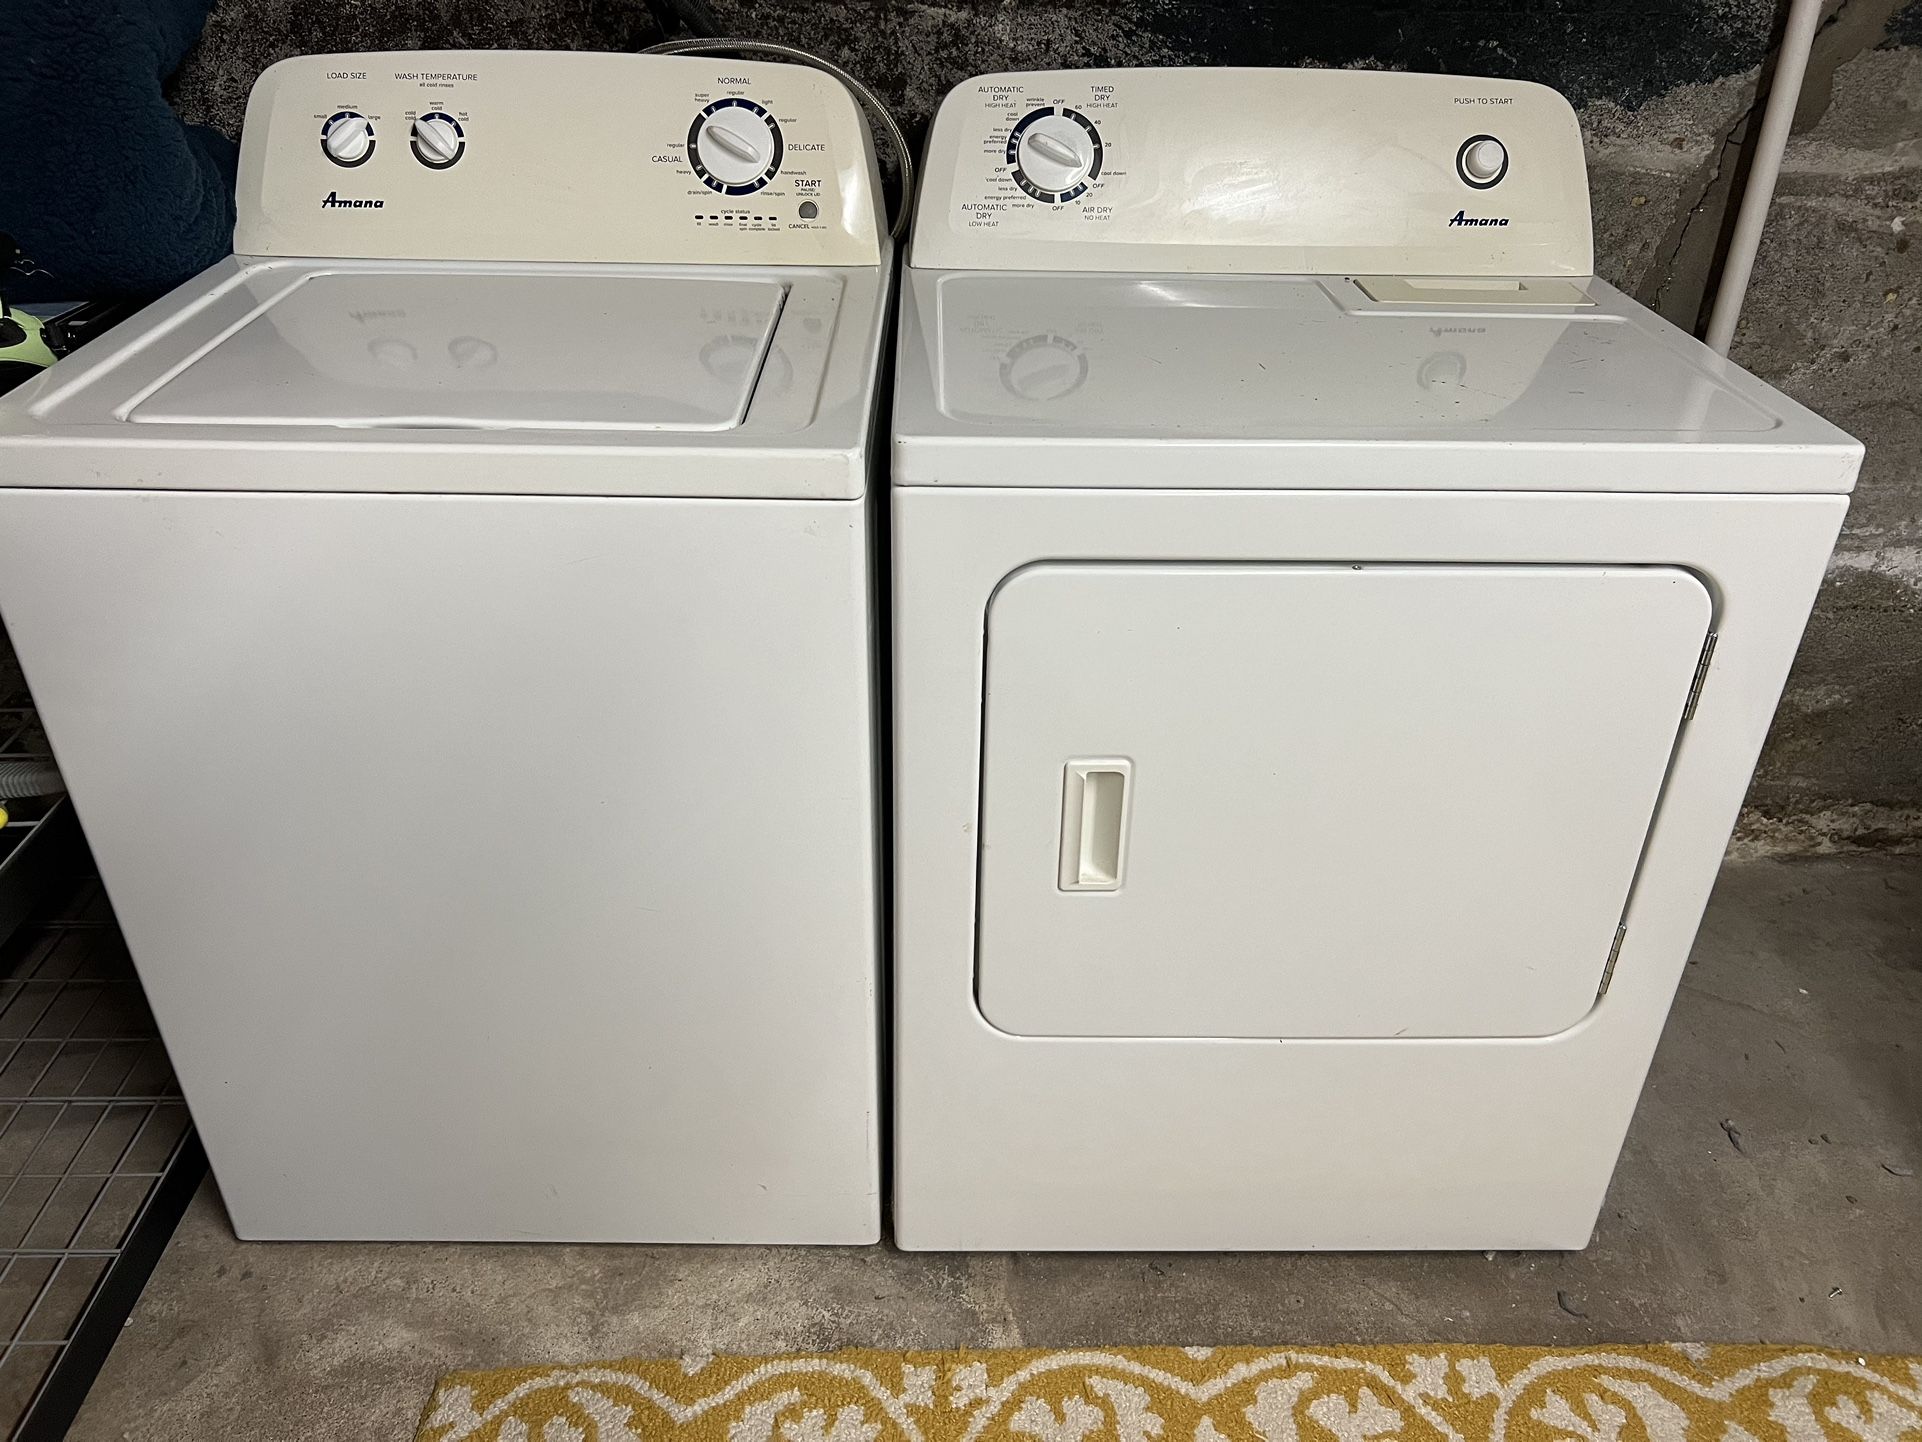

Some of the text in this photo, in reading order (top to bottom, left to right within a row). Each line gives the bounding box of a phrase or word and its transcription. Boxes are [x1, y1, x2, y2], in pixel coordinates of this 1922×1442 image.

[326, 72, 367, 80] LOAD SIZE
[394, 72, 478, 81] WASH TEMPERATURE
[717, 77, 752, 85] NORMAL
[992, 94, 1009, 102] DRY
[1453, 97, 1476, 105] PUSH
[1477, 97, 1488, 105] TO
[787, 143, 826, 152] DELICATE
[651, 155, 684, 163] CASUAL
[794, 179, 822, 188] START
[321, 191, 385, 209] Amana
[961, 203, 1008, 211] AUTOMATIC
[1081, 206, 1113, 214] AIR DRY
[975, 212, 993, 220] DRY
[1448, 210, 1510, 227] Amana
